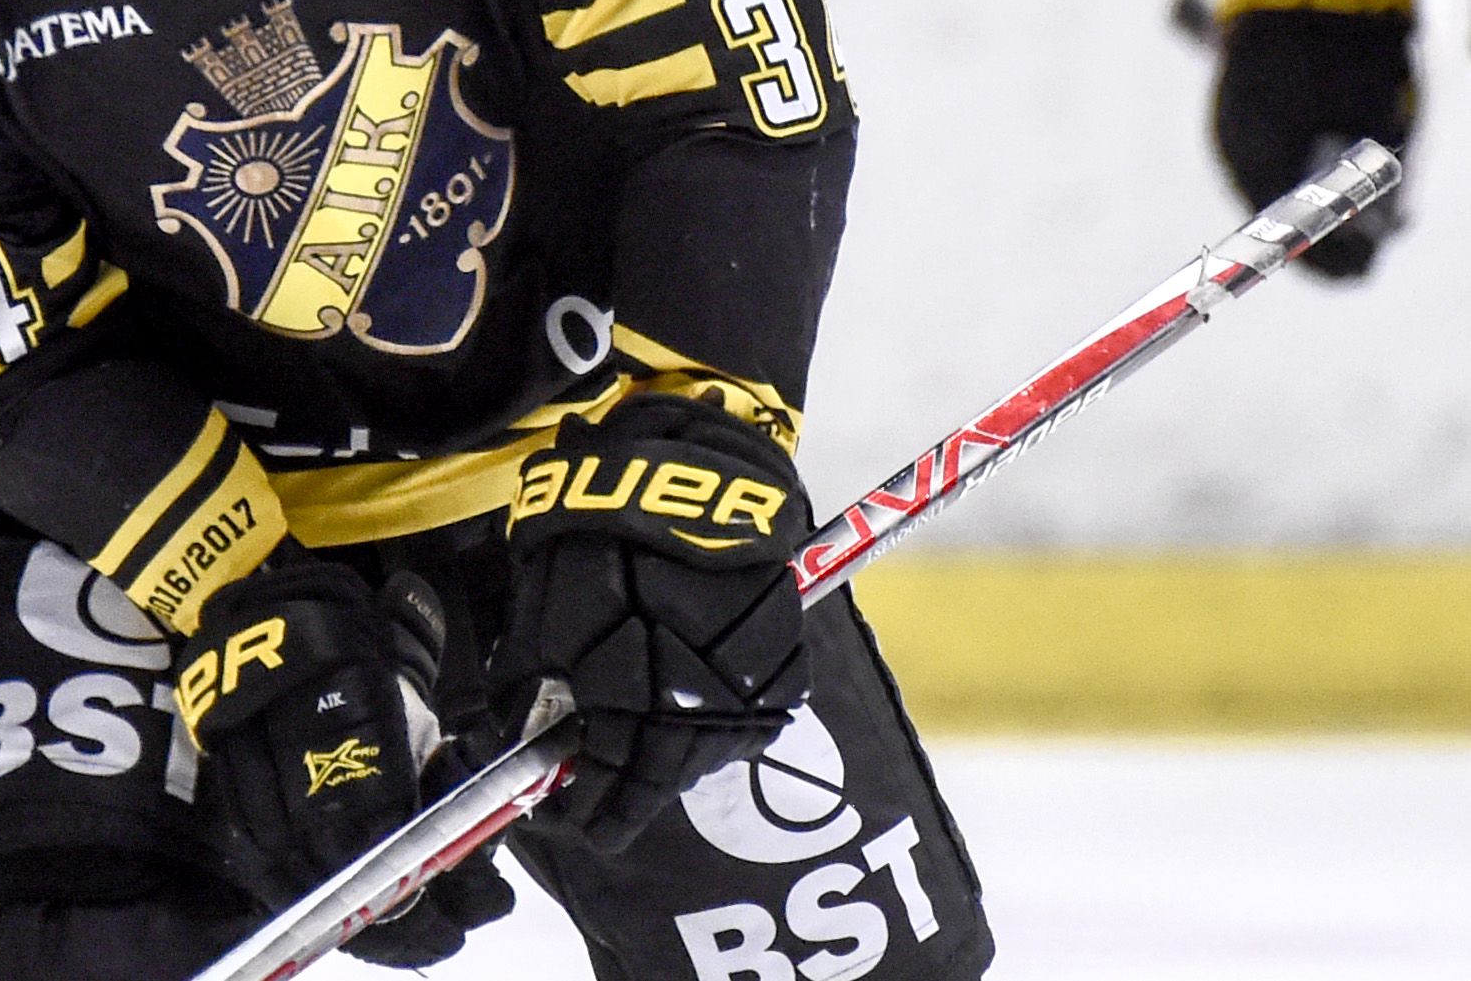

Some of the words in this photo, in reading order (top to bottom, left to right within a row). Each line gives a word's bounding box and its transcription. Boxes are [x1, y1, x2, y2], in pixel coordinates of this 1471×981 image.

[505, 456, 788, 540] AUER
[788, 424, 1011, 595] VAP
[674, 816, 940, 981] BST
